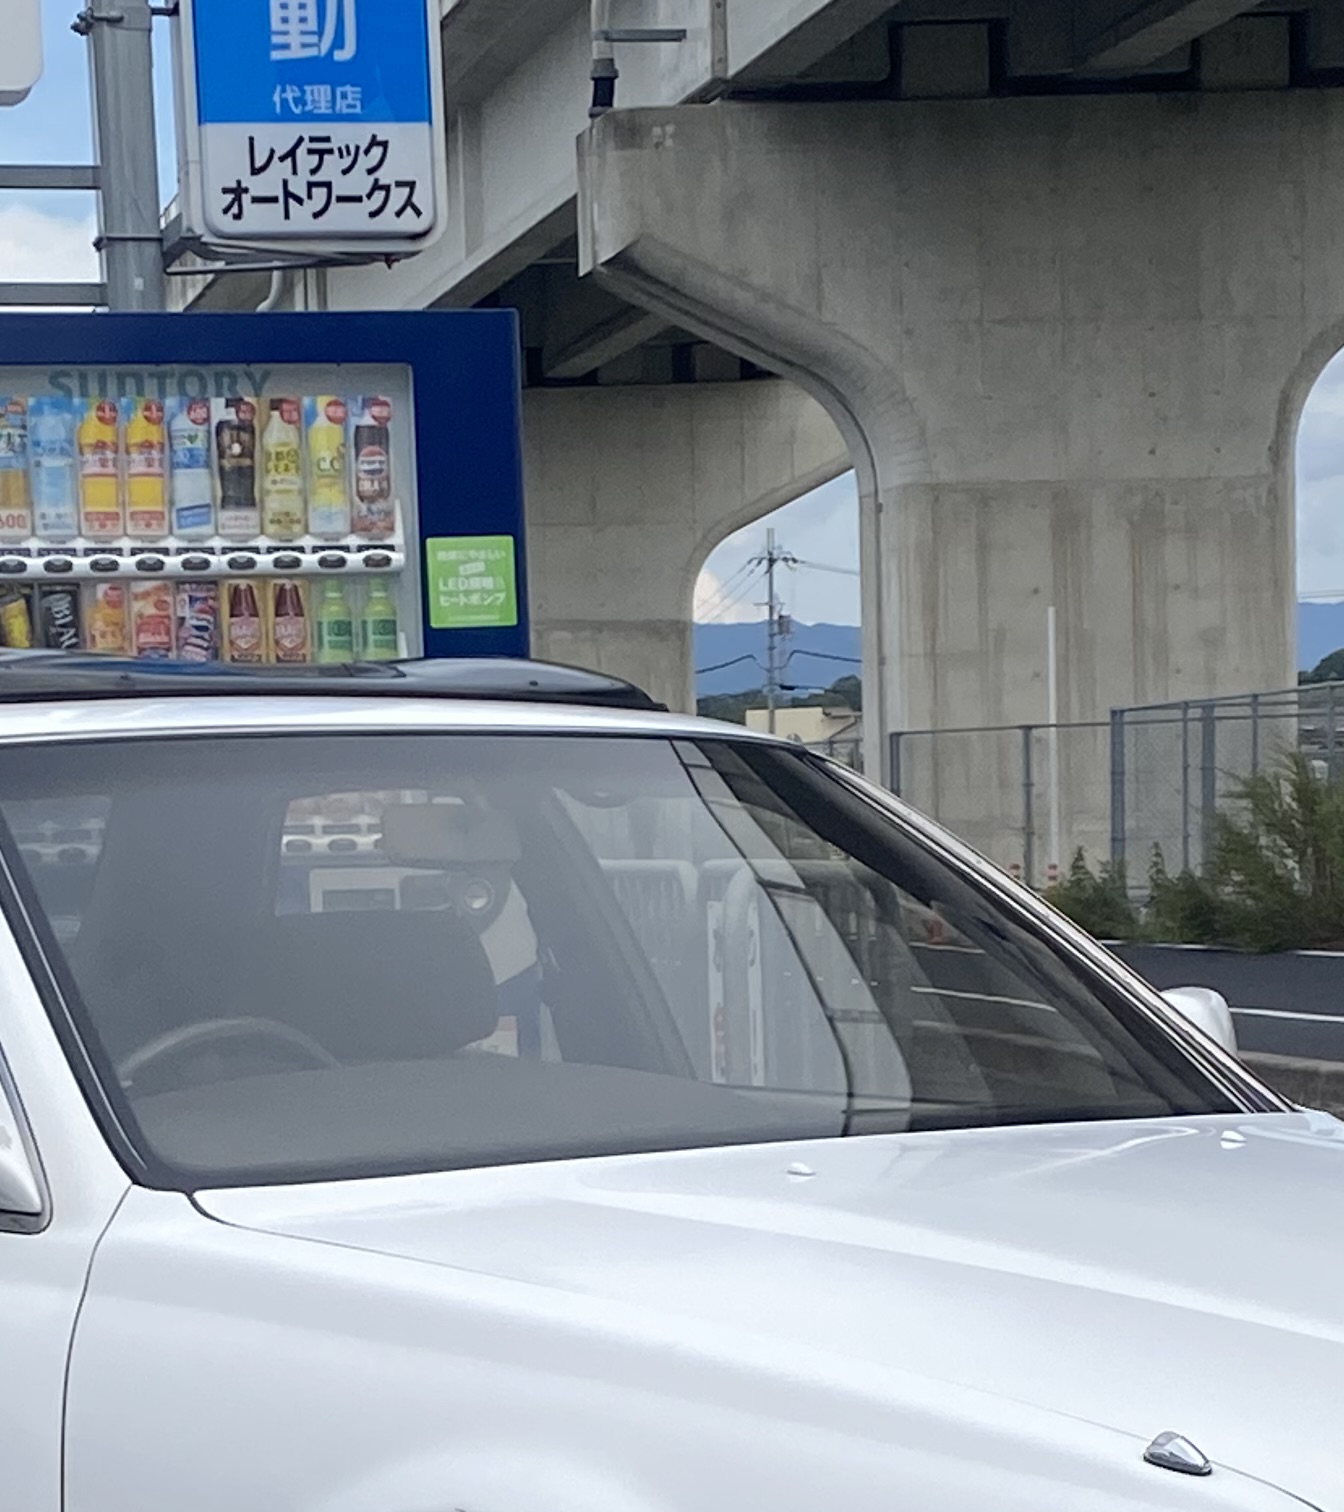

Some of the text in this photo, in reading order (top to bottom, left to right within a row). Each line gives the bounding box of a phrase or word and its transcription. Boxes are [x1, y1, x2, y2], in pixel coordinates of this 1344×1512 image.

[272, 84, 362, 114] 代理店
[248, 134, 389, 176] レイテック
[221, 178, 423, 220] オートワークス
